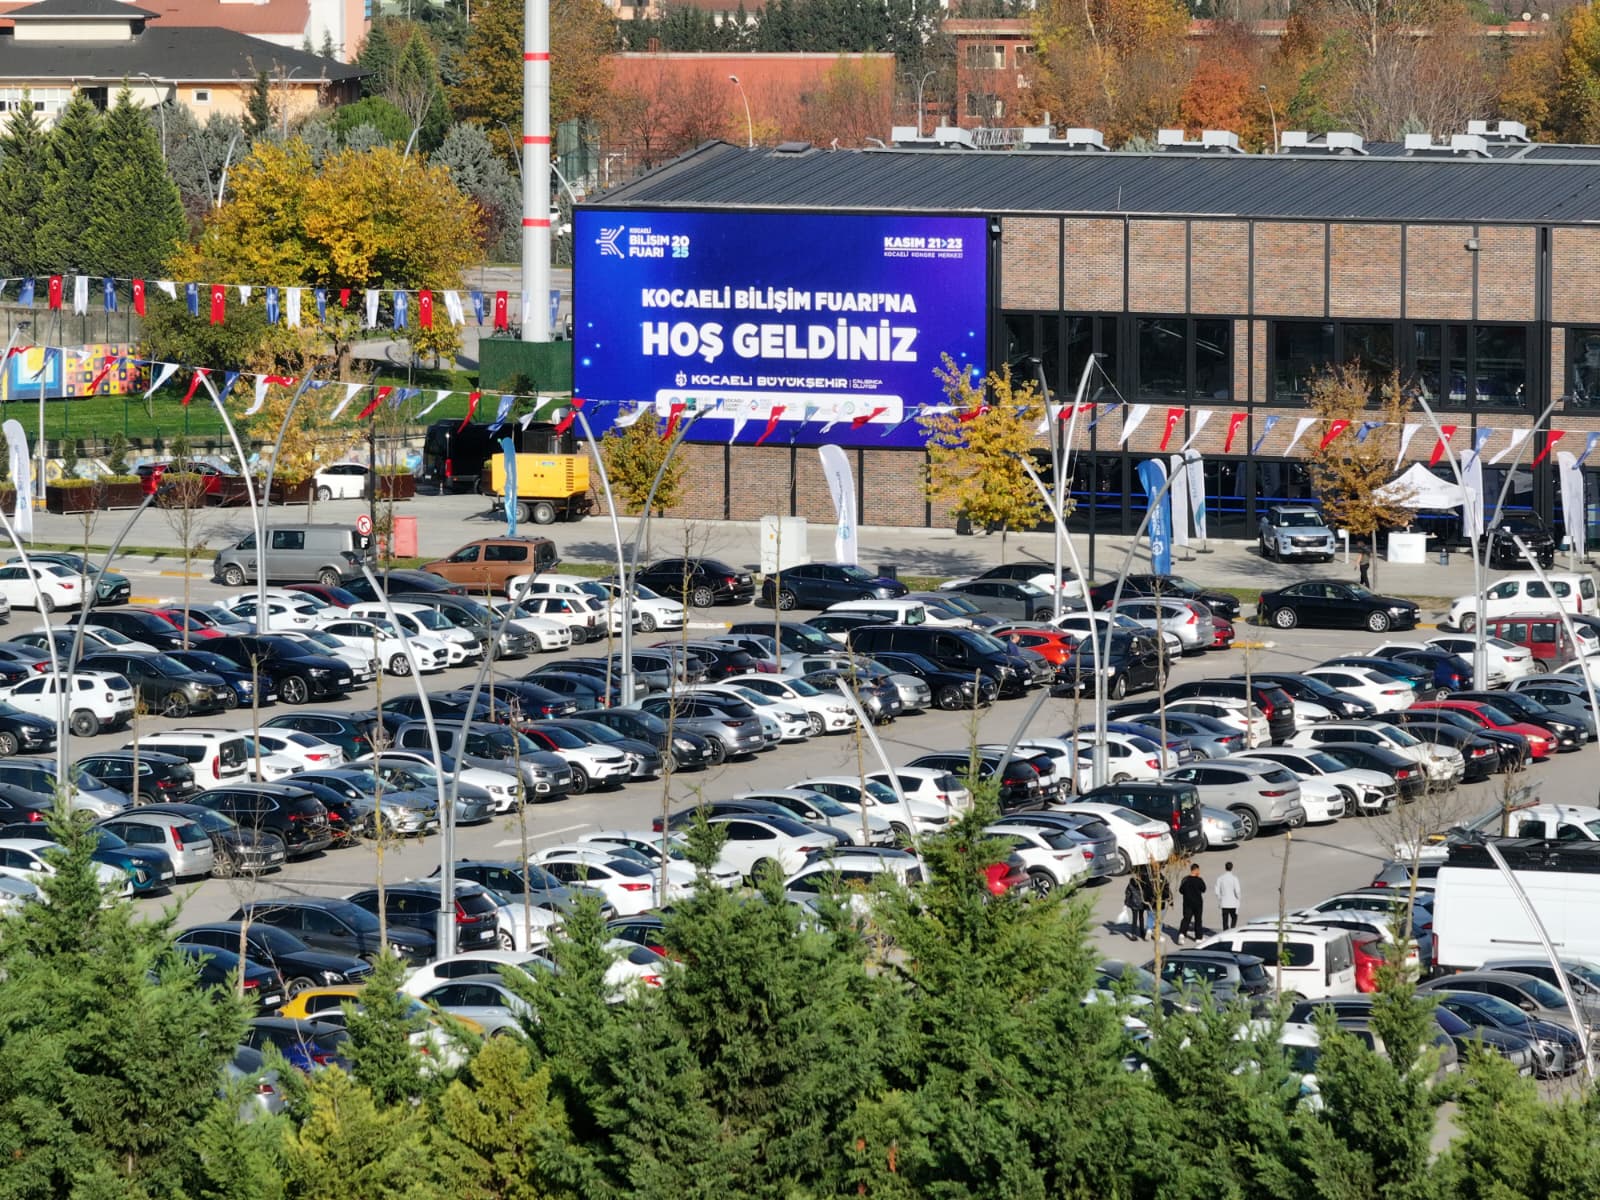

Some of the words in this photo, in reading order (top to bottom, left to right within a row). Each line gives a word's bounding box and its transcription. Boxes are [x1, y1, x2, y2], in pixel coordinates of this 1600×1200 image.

[671, 235, 690, 247] 20
[883, 236, 925, 248] KASIM
[629, 246, 664, 258] FUARI
[672, 246, 690, 258] 25
[641, 286, 731, 309] KOCAELİ
[735, 286, 811, 313] BİLİŞİM
[815, 291, 917, 313] FUARI'NA
[642, 321, 724, 364] HOŞ
[732, 317, 918, 362] GELDİNİZ
[691, 375, 752, 386] KOCAELİ
[757, 376, 848, 389] BÜYÜKŞEHİR
